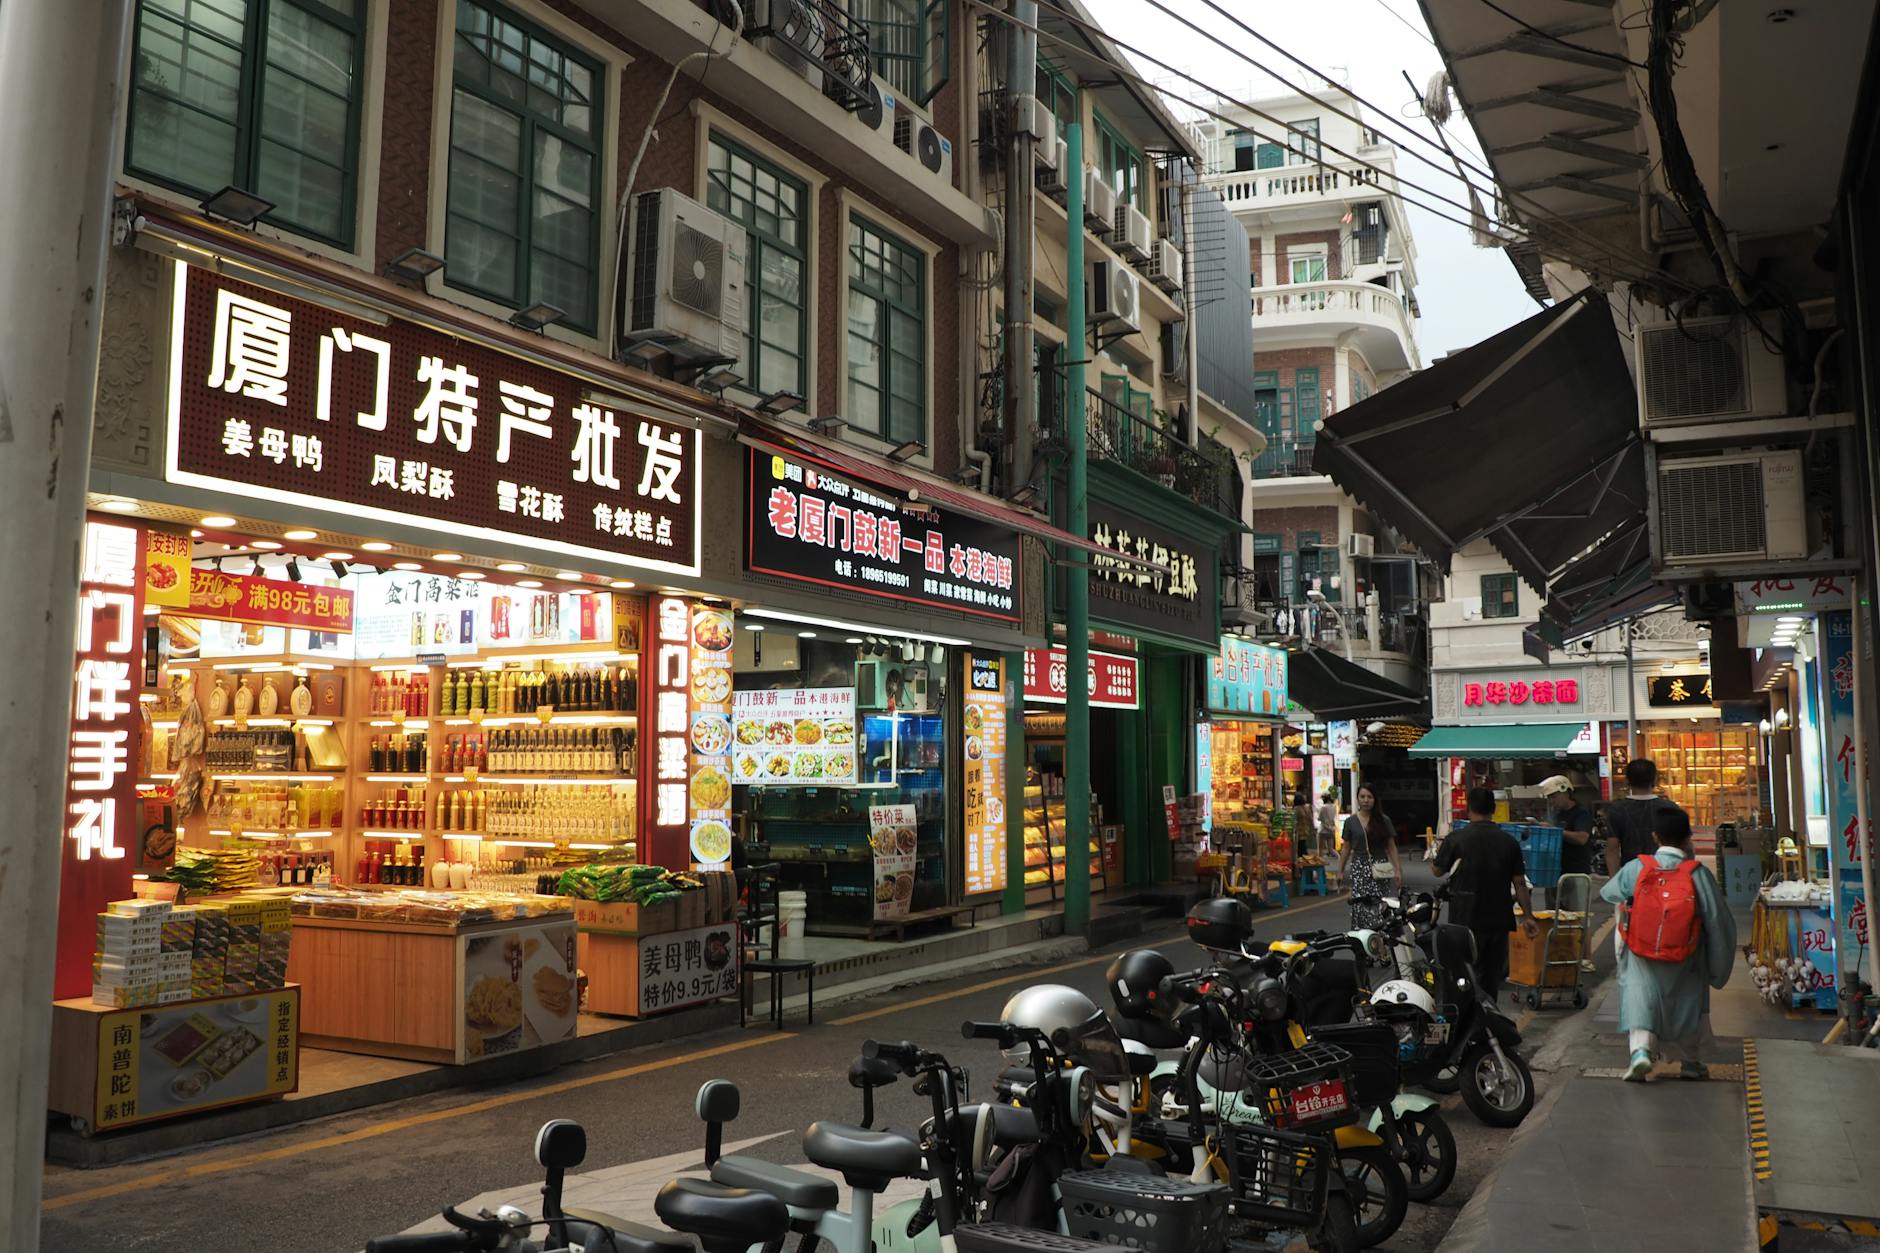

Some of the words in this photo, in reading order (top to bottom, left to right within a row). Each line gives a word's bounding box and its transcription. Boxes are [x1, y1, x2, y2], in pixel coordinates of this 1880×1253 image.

[208, 288, 683, 503] 厦门特产批发
[222, 417, 323, 473] 姜母鸭
[370, 454, 454, 501] 凤梨酥
[497, 480, 564, 523] 雪花酥
[593, 503, 672, 546] 传统糕点
[768, 485, 945, 574] 老厦门鼓新一品
[949, 543, 1013, 590] 本港海鲜
[248, 583, 350, 619] 满98元包邮
[1464, 678, 1578, 707] 月华沙茶面
[872, 808, 905, 826] 特价菜
[643, 939, 702, 980] 姜母鸭
[643, 968, 737, 1009] 特价9.9元/袋
[111, 1023, 134, 1097] 南普陀
[275, 1000, 292, 1083] 指定经销点
